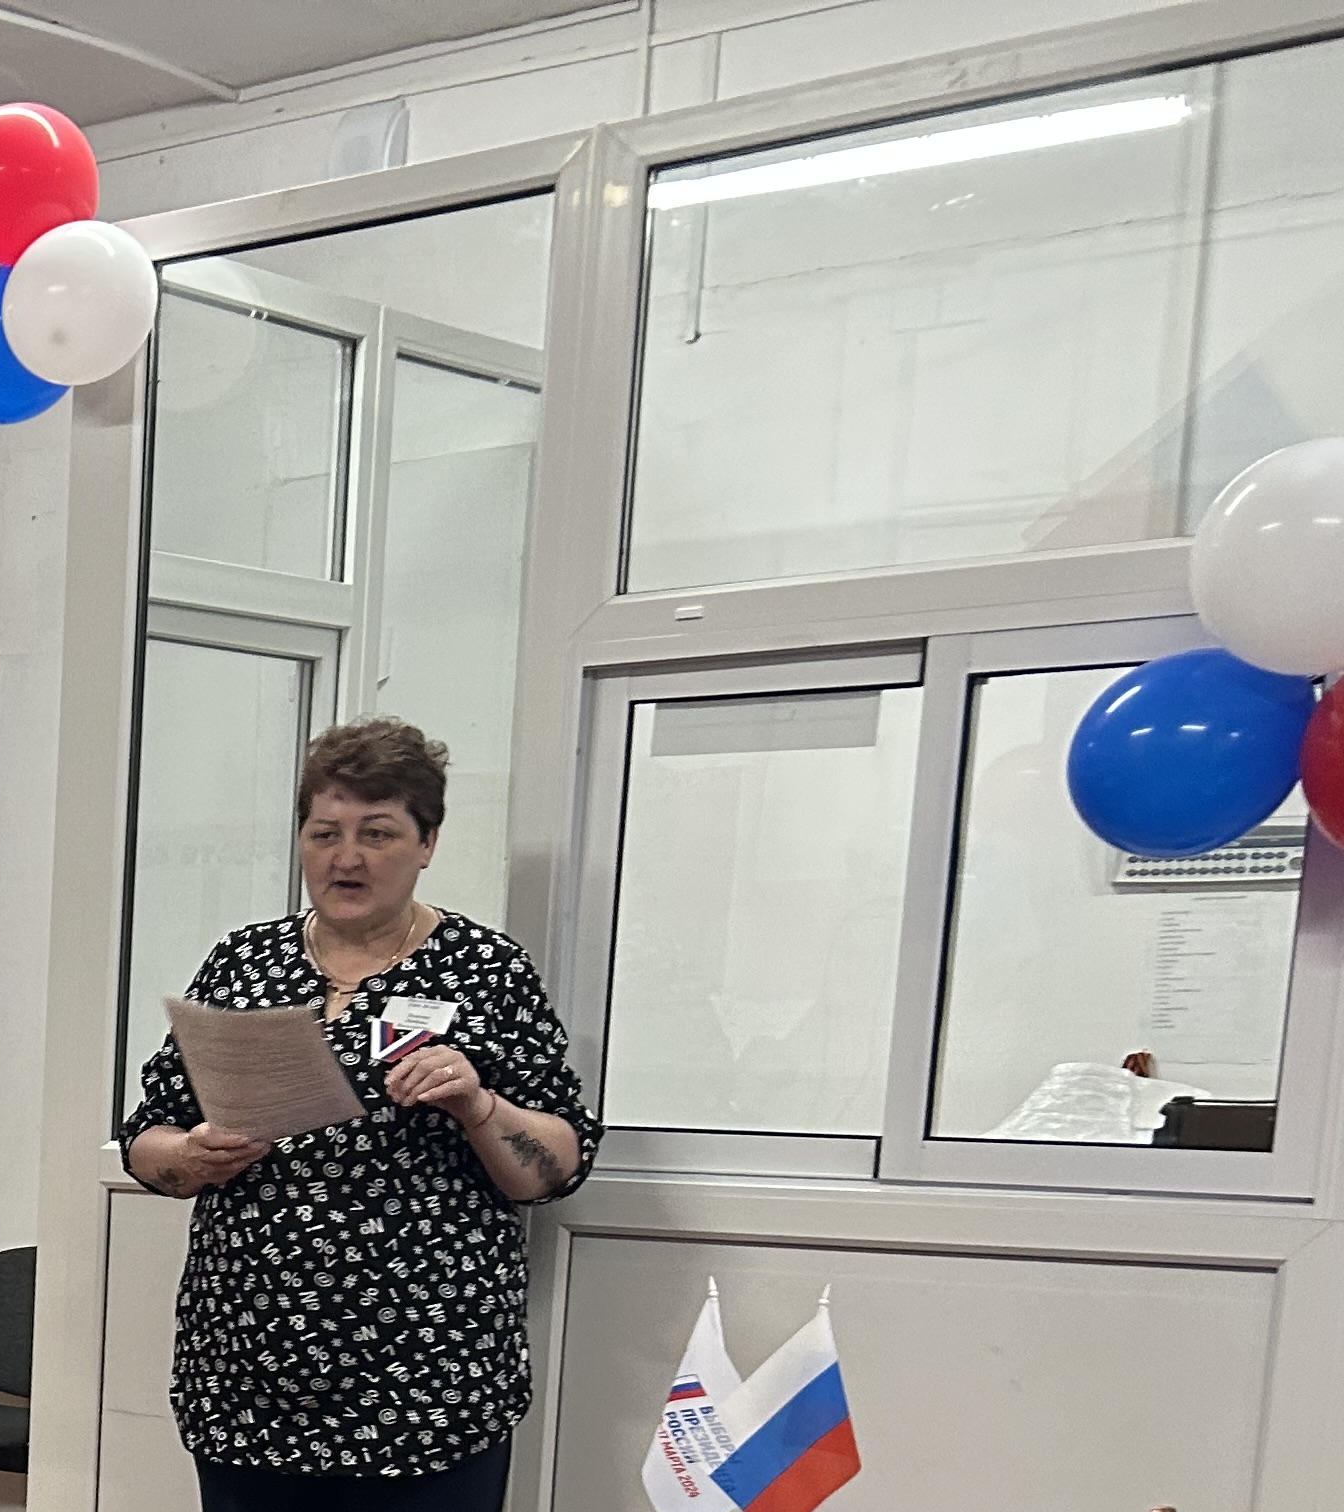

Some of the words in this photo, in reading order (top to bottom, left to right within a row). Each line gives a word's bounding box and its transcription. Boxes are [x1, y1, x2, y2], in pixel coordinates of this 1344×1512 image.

[665, 1411, 703, 1464] РОССИИ
[661, 1441, 688, 1474] МАРТА
[677, 1475, 702, 1498] 2024
